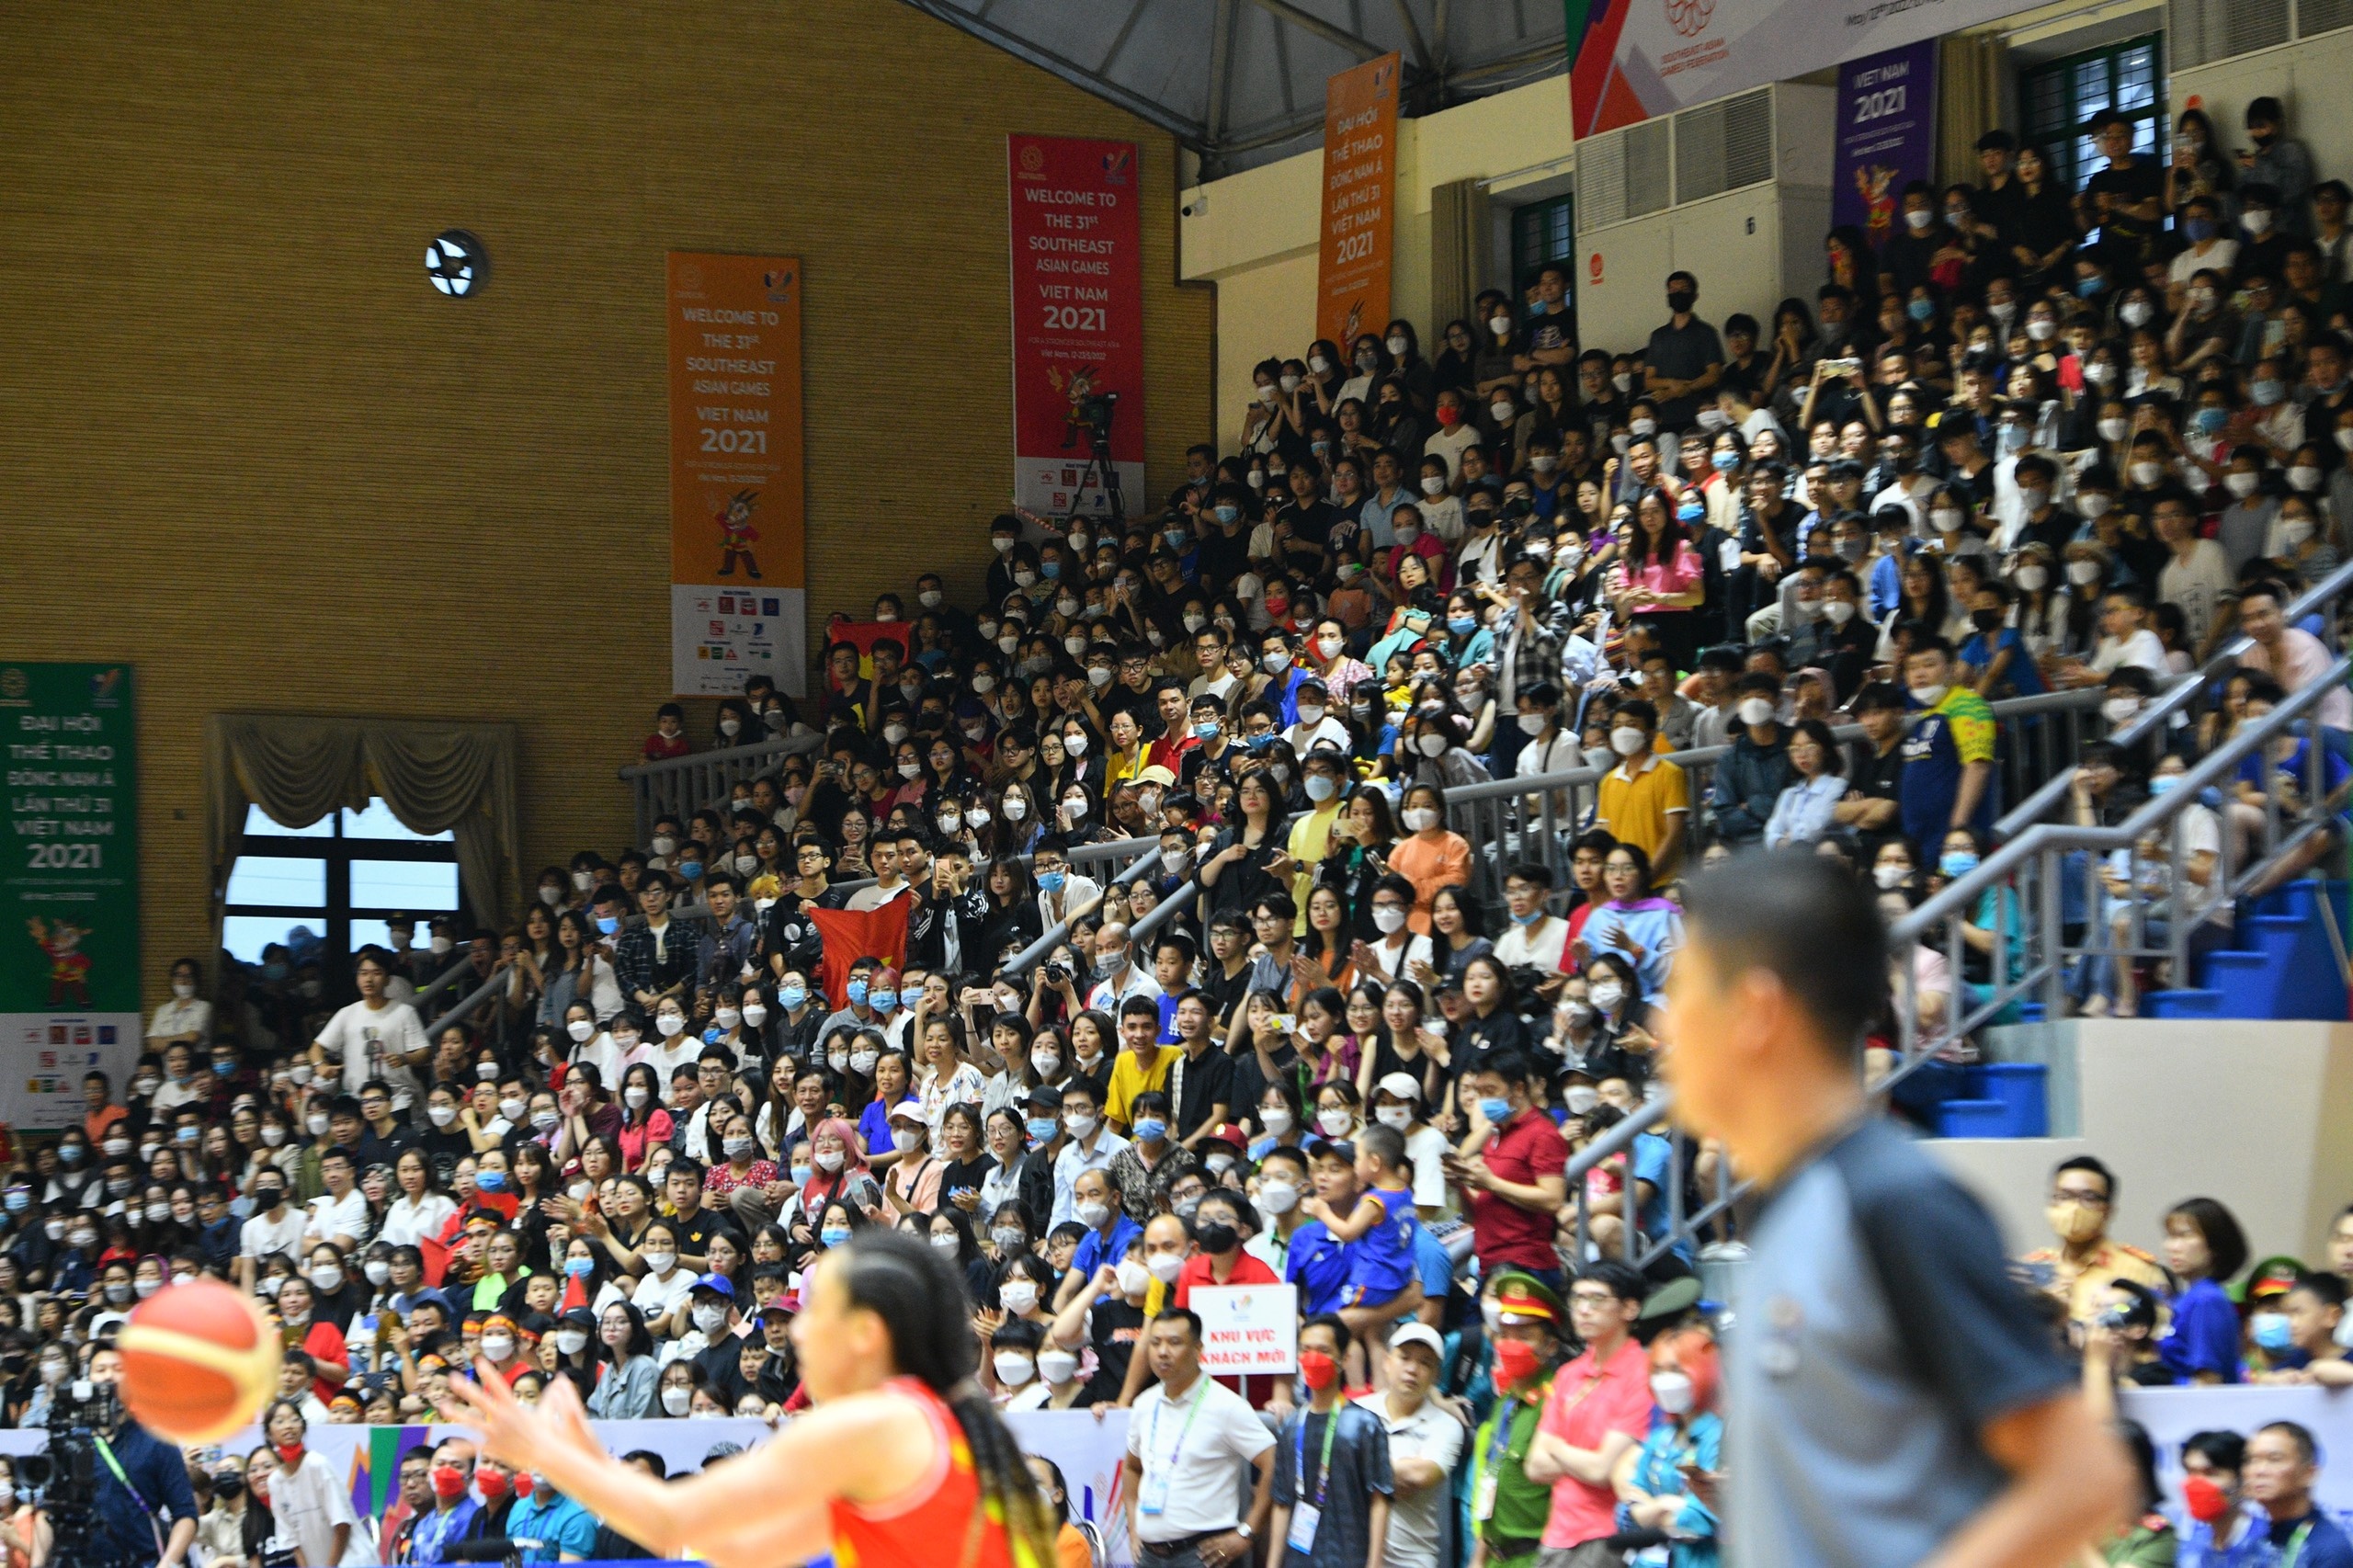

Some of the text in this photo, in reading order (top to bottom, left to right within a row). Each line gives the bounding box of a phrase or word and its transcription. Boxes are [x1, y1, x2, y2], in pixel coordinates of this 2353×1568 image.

[1854, 61, 1910, 88] VIET NAM
[1852, 85, 1906, 124] 2021
[1352, 133, 1384, 156] THAO
[1355, 163, 1374, 184] NAM
[1025, 187, 1117, 208] WELCOME TO
[1044, 213, 1099, 230] THE 31st
[1355, 206, 1381, 228] NAM
[1029, 235, 1115, 256] SOUTHEAST
[1336, 230, 1374, 266] 2021
[1036, 258, 1109, 276] ASIAN GAMES
[1040, 285, 1108, 301] VIET NAM
[682, 307, 779, 326] WELCOME TO
[1042, 305, 1107, 332] 2021
[701, 333, 733, 349] THE
[685, 357, 777, 376] SOUTHEAST
[693, 379, 771, 397] ASIAN GAMES
[696, 406, 770, 424] VIET NAM
[699, 427, 767, 454] 2021
[55, 744, 116, 759] THAO
[63, 820, 116, 835] NAM
[26, 843, 104, 869] 2021
[1210, 1327, 1276, 1344] KHU VỰC
